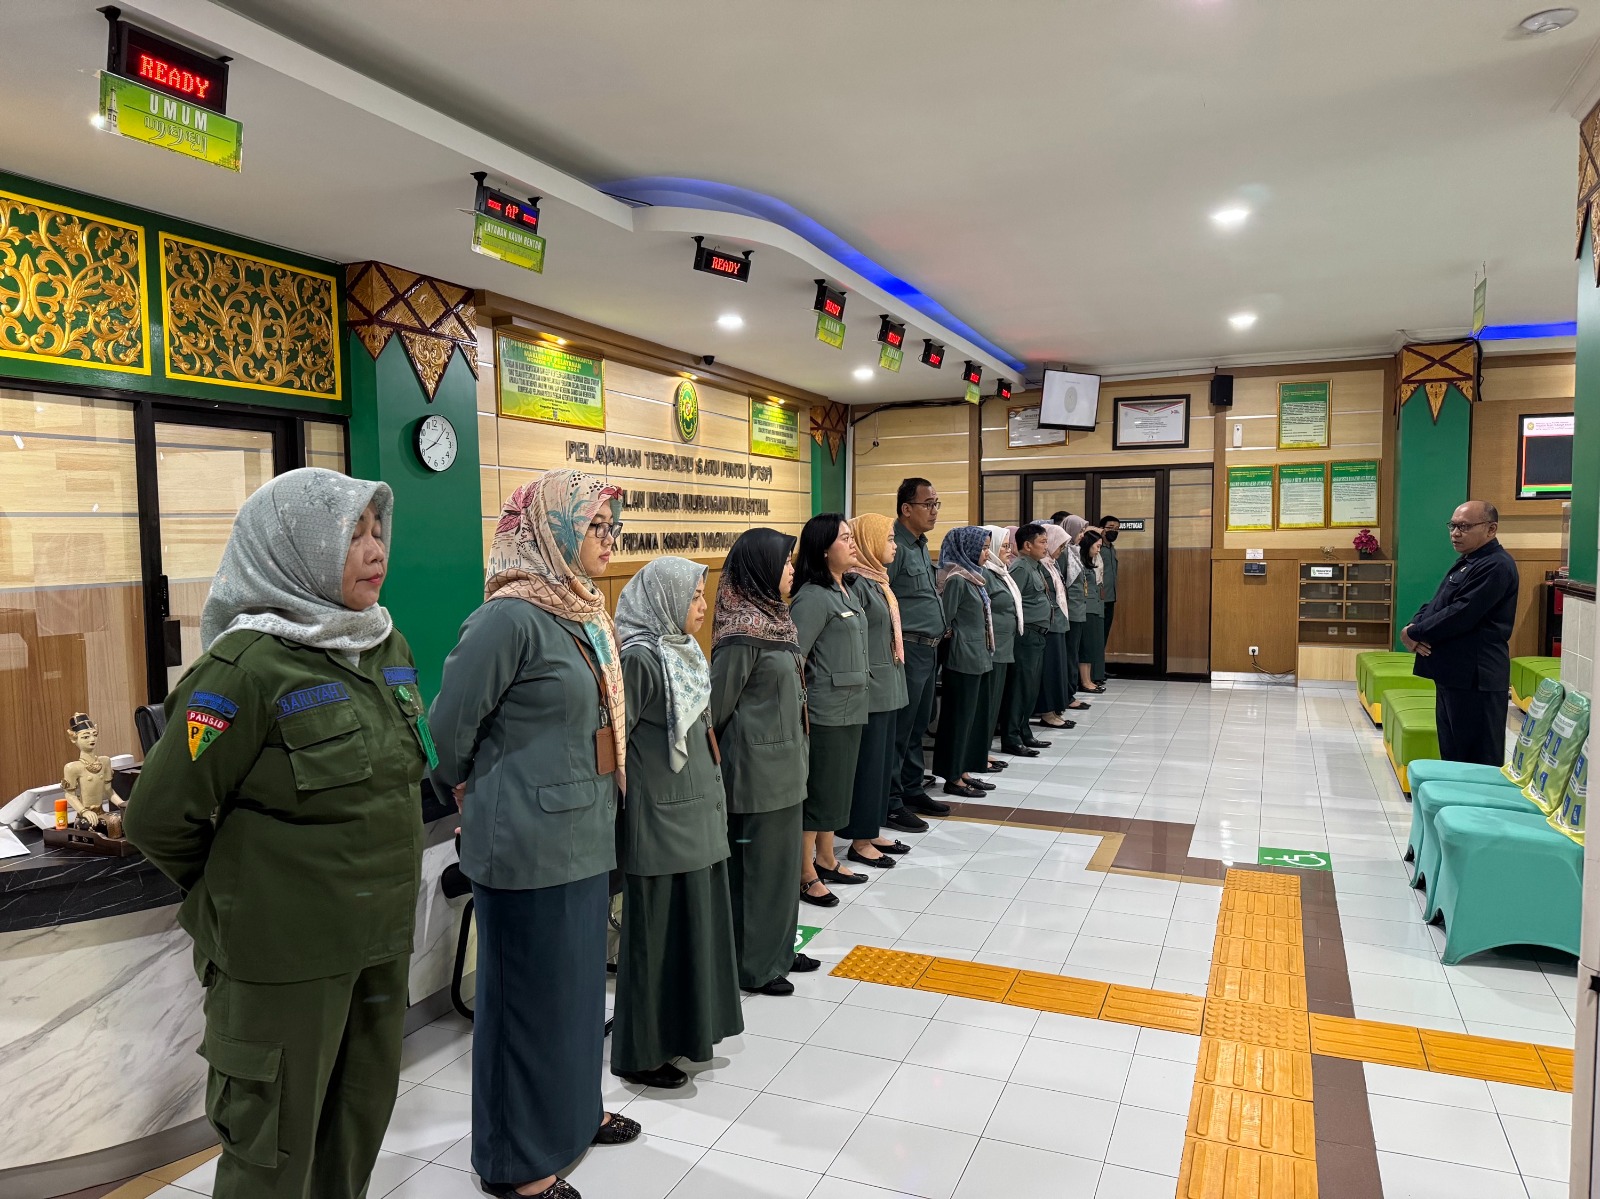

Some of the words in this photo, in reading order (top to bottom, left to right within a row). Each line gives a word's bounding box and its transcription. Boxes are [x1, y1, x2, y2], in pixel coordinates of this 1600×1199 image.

[140, 54, 210, 98] READY
[149, 93, 208, 132] UMUM
[505, 203, 519, 219] AP
[484, 221, 508, 239] LAYANAN
[711, 256, 741, 275] READY
[565, 440, 641, 469] PELAYANAN
[643, 451, 694, 473] TERPADU
[695, 457, 720, 476] SATU
[720, 461, 747, 479] PINTU
[748, 462, 773, 484] (PTSP)
[620, 532, 659, 553] PIDANA
[660, 532, 699, 553] KORUPSI
[281, 685, 340, 713] BARIYAH
[191, 726, 199, 739] P
[202, 730, 213, 743] S
